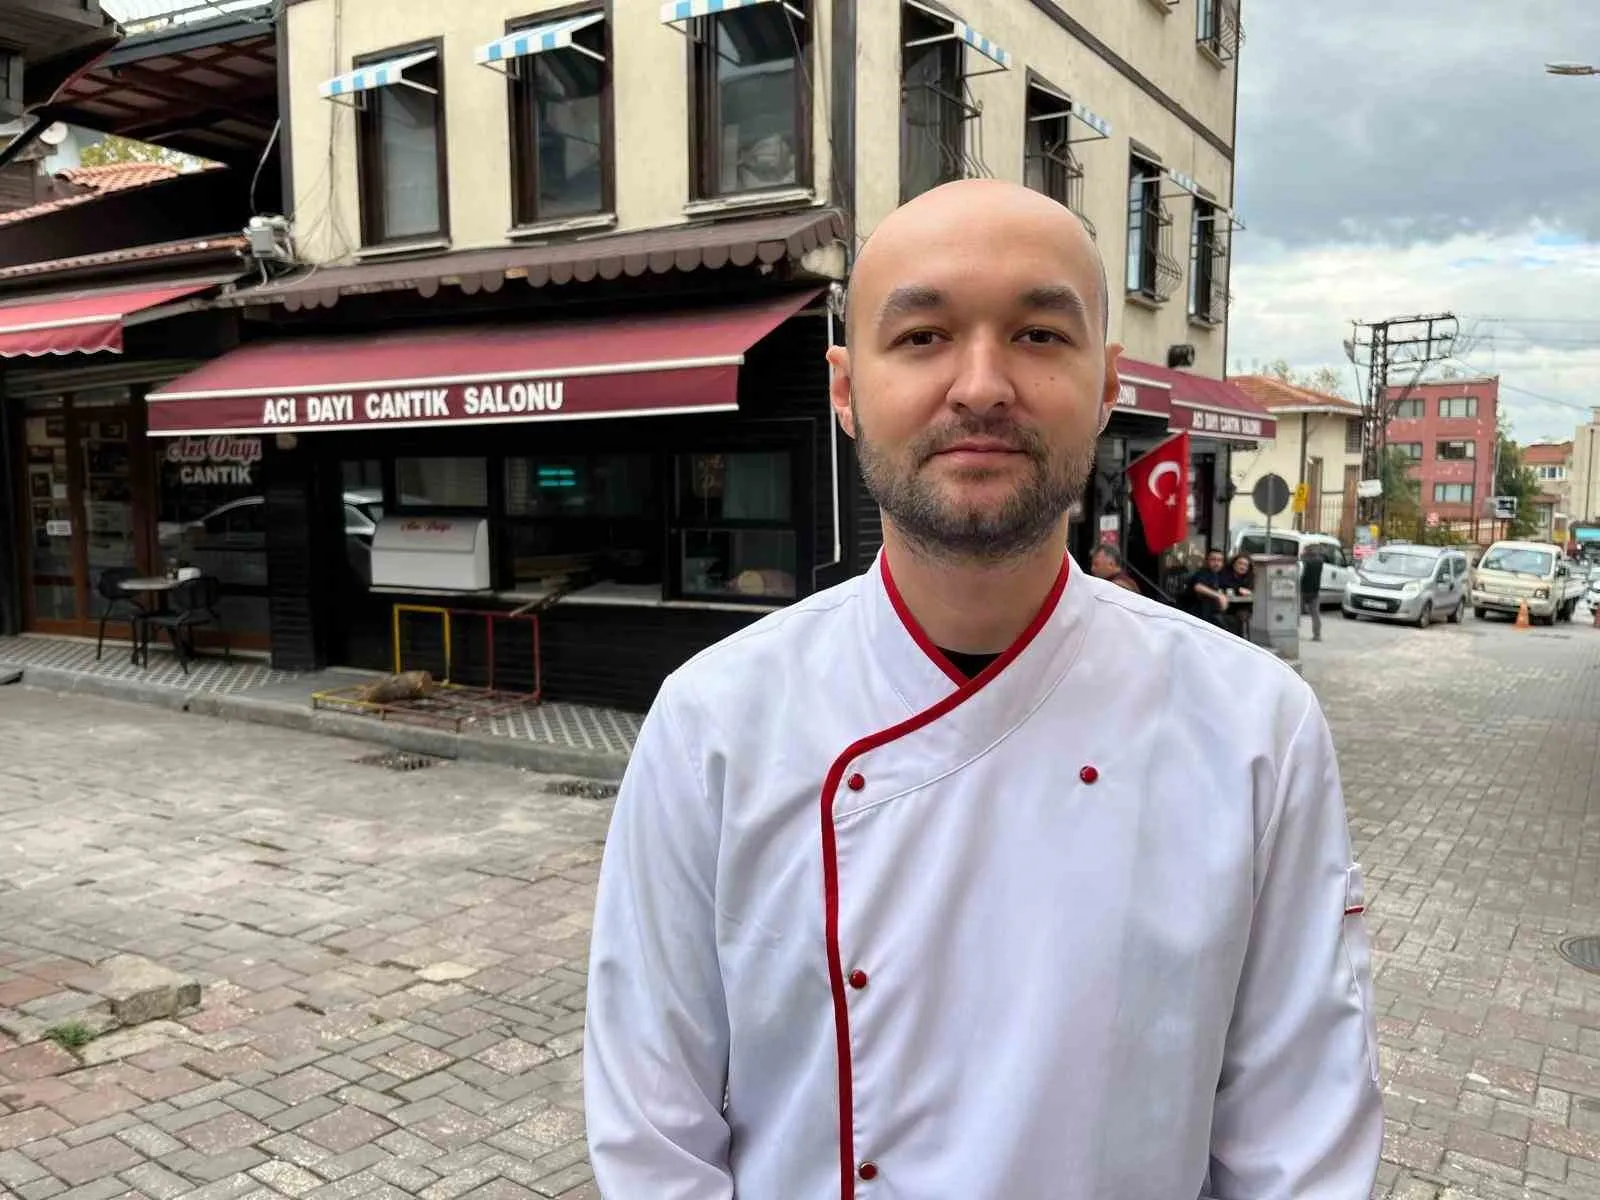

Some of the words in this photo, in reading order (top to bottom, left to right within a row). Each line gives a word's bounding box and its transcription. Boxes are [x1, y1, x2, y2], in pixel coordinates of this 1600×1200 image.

[263, 398, 296, 425] ACI
[306, 395, 354, 422] DAYI
[365, 388, 450, 419] CANTIK
[463, 382, 564, 414] SALONU
[180, 465, 253, 485] CANTIK
